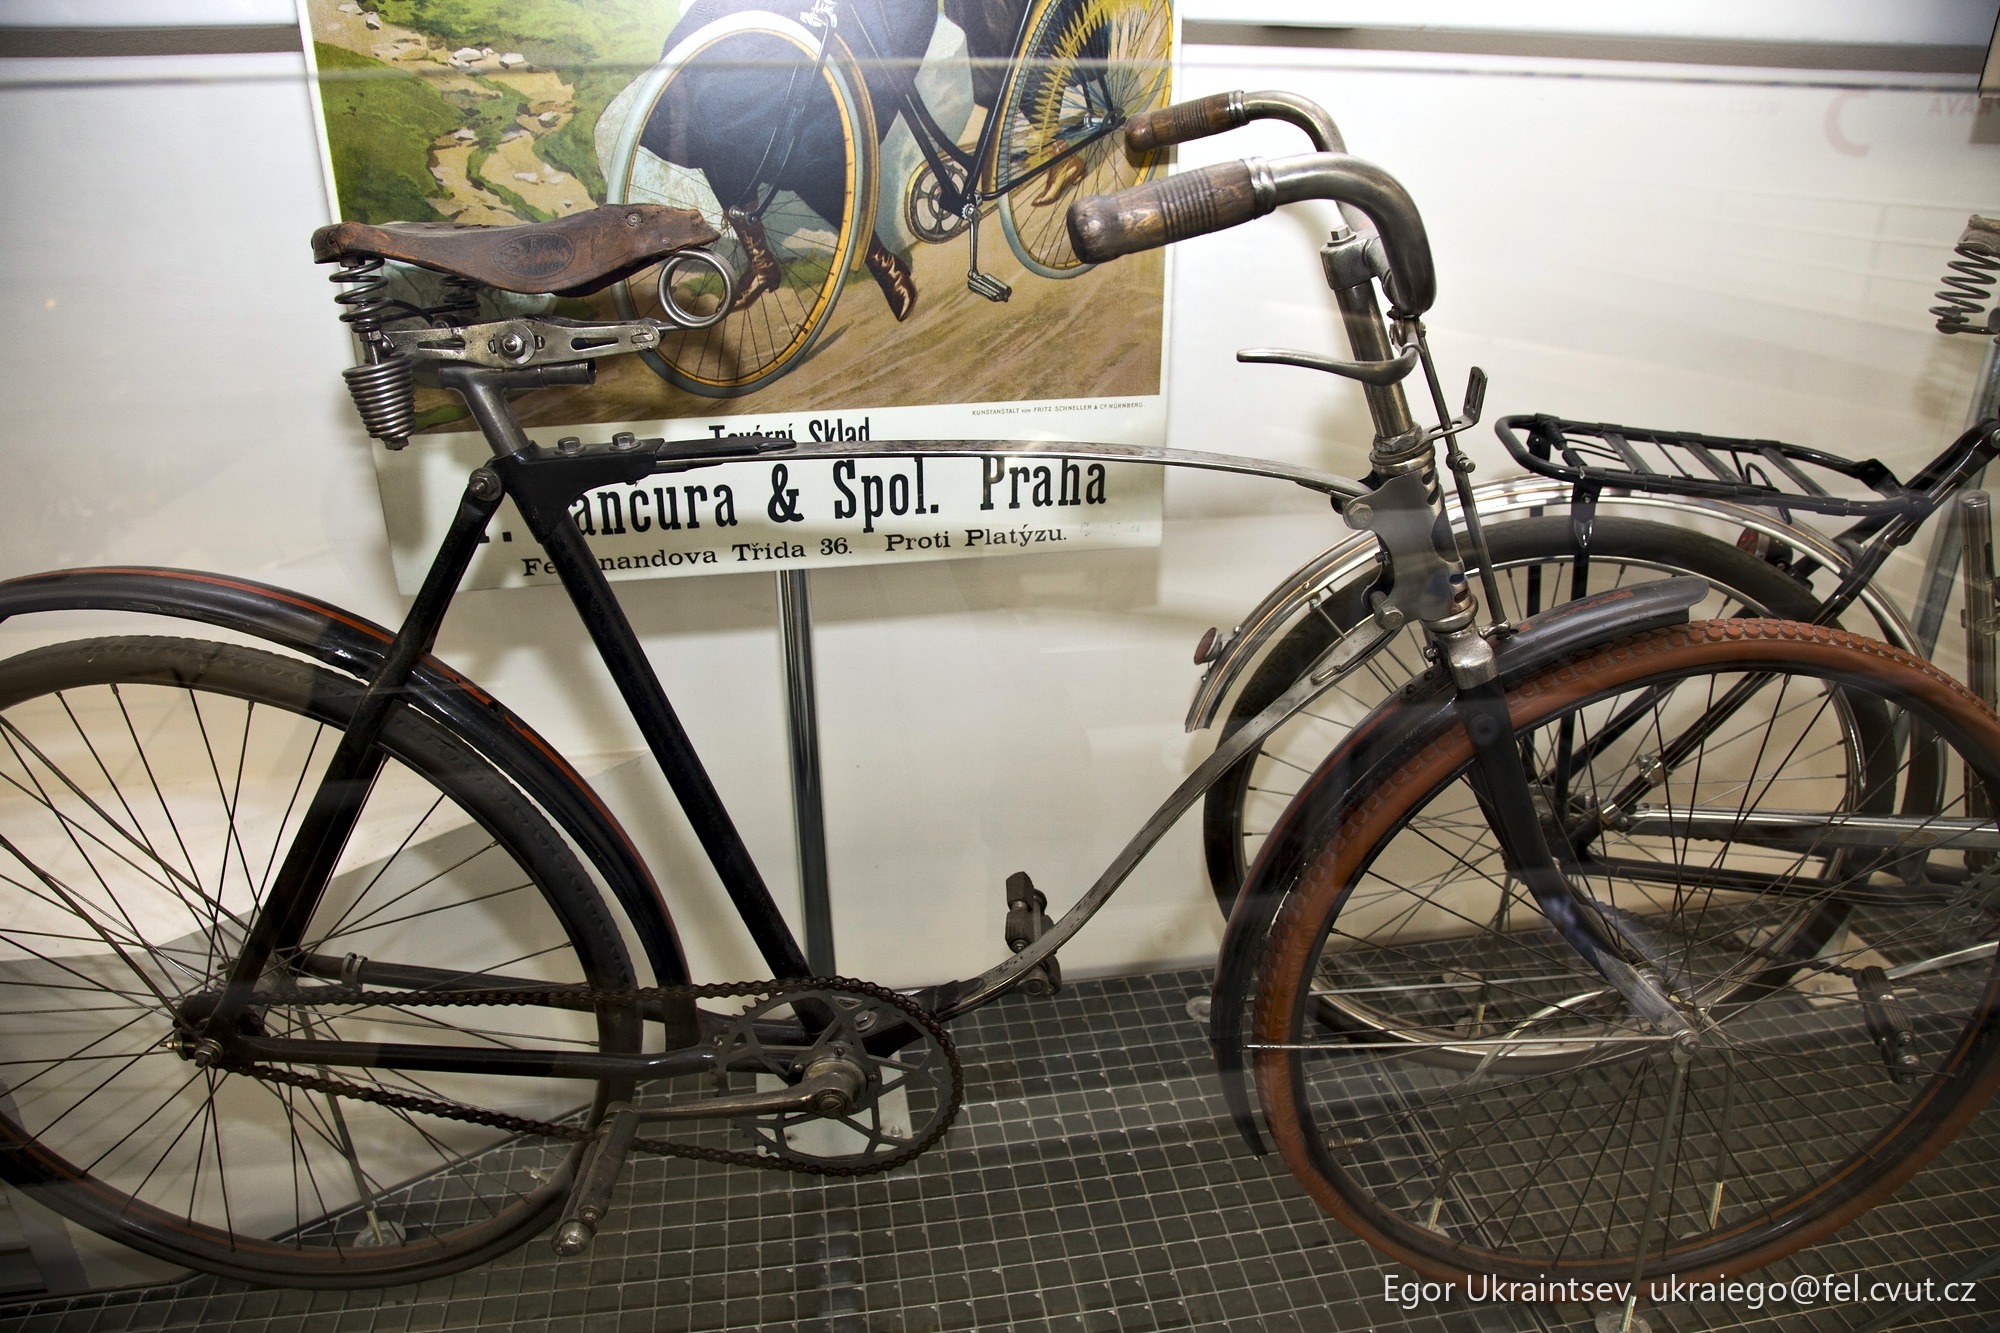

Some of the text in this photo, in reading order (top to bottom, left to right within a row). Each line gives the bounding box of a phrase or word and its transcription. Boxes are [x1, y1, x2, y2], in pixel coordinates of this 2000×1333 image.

[972, 408, 1020, 416] KUNSTANSTALT
[1055, 404, 1092, 412] SCHNELLER
[767, 463, 805, 523] &
[832, 456, 939, 533] Spol.
[980, 456, 1107, 511] Praha
[820, 537, 853, 556] 36.
[884, 530, 951, 552] Proti
[964, 523, 1067, 547] Platýzu.
